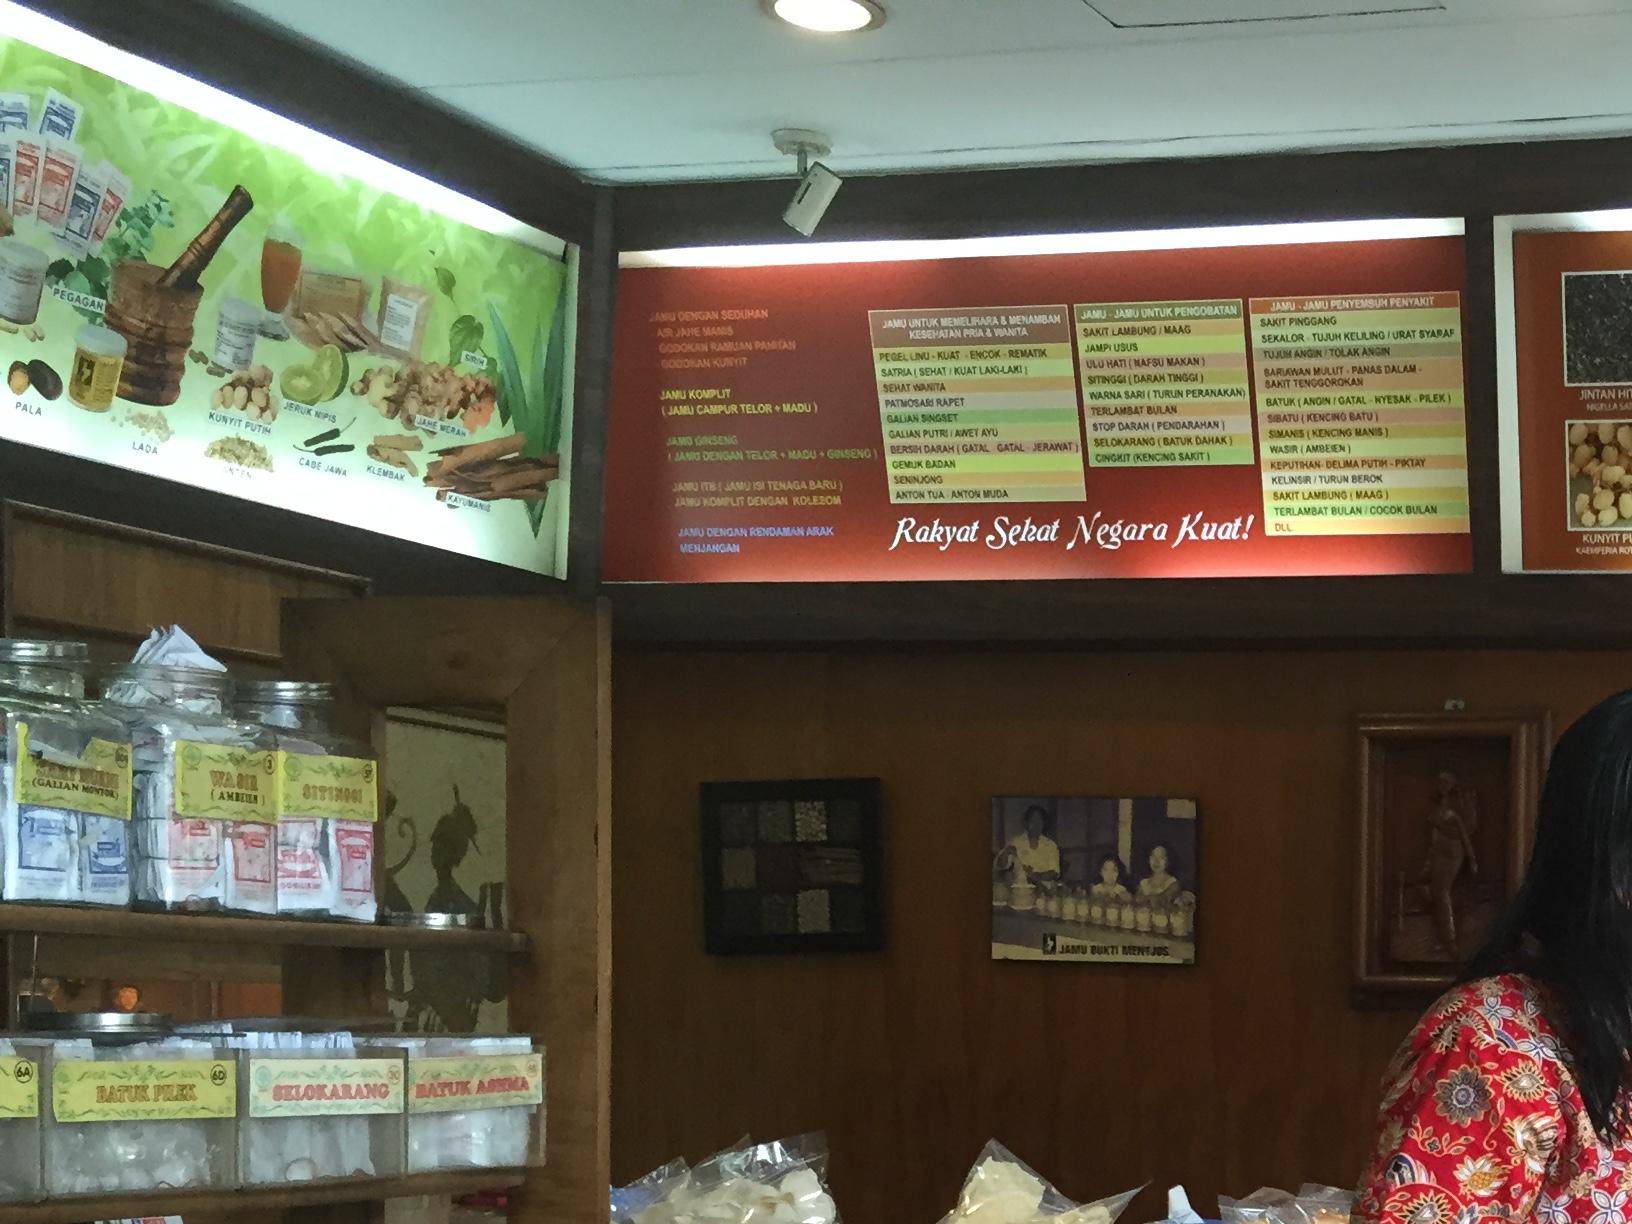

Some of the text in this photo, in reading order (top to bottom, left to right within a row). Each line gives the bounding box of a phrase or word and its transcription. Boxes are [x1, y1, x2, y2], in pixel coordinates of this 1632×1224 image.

[53, 287, 104, 311] PEGAGAN
[1260, 316, 1336, 327] SAKIT PINGGANG
[1083, 325, 1191, 337] SAKIT LAMBUNG MAAG
[1085, 343, 1138, 352] JAMPI USUS
[883, 383, 945, 392] SEHAT WANITA
[660, 389, 731, 400] JAMU KOMPLIT
[1580, 389, 1615, 400] JINTAN
[15, 401, 42, 416] PALA
[284, 402, 337, 423] JERUK NIPIS
[1091, 406, 1177, 416] TERLAMBAT BULAN
[209, 411, 271, 435] KUNYIT PUTIH
[887, 414, 958, 423] GALIAN SINGSET
[416, 417, 466, 437] JAHE MERAH
[889, 430, 920, 438] GALIAN
[923, 429, 948, 438] PUTRI
[1094, 436, 1227, 447] SELOKARANG BATUK DAHAK
[132, 441, 158, 455] LADA
[299, 457, 347, 477] CABE JAWA
[892, 460, 955, 469] GEMUK BADAN
[367, 465, 406, 481] KLEMBAK
[894, 476, 943, 484] SENINJONG
[1272, 474, 1383, 484] KELINSIR TURUN BEROK
[896, 491, 924, 499] ANTON
[951, 490, 980, 498] ANTON
[983, 490, 1008, 498] MUDA
[448, 494, 490, 512] KAYUMANIS
[1275, 506, 1437, 516] TERLAMBAT BULAN COCOK BULAN
[889, 511, 1255, 550] Rakyat Sehat Negara Kuat!
[1275, 523, 1292, 532] DLL
[1582, 534, 1620, 544] KUNYIT
[1059, 945, 1087, 954] JAMU
[1090, 945, 1118, 955] BUKTI
[17, 1066, 31, 1077] 6A
[97, 1084, 198, 1103] BATUK PILEK
[272, 1084, 390, 1101] SELOKARANG
[416, 1081, 470, 1098] BATUK
